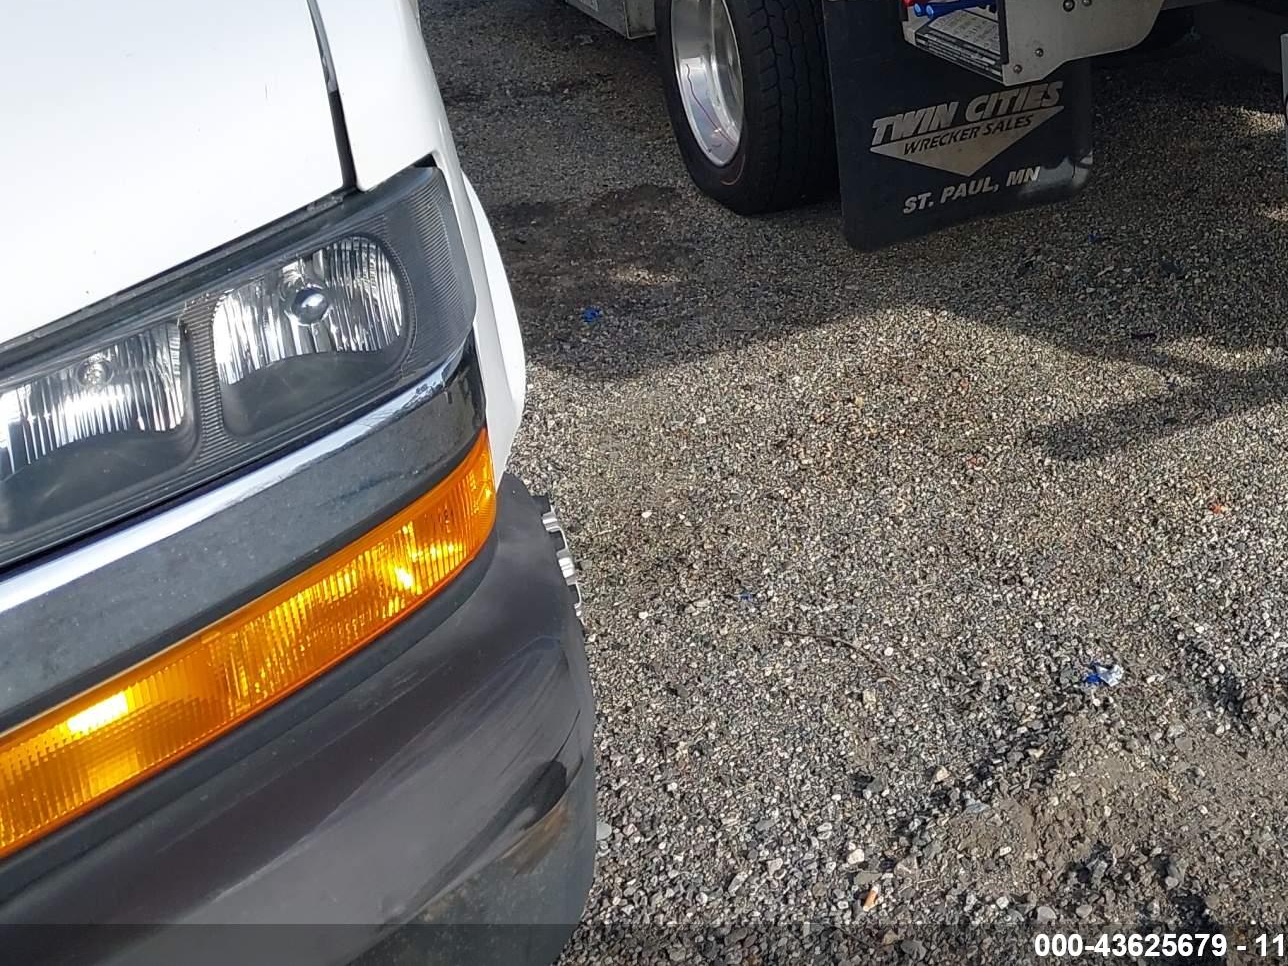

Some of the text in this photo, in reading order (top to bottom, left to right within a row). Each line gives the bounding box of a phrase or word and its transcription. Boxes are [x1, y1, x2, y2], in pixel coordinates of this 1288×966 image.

[871, 81, 1064, 146] TWIN CITIES
[903, 114, 1034, 155] WRECKER SALES
[903, 166, 1042, 214] ST. PAUL, MN
